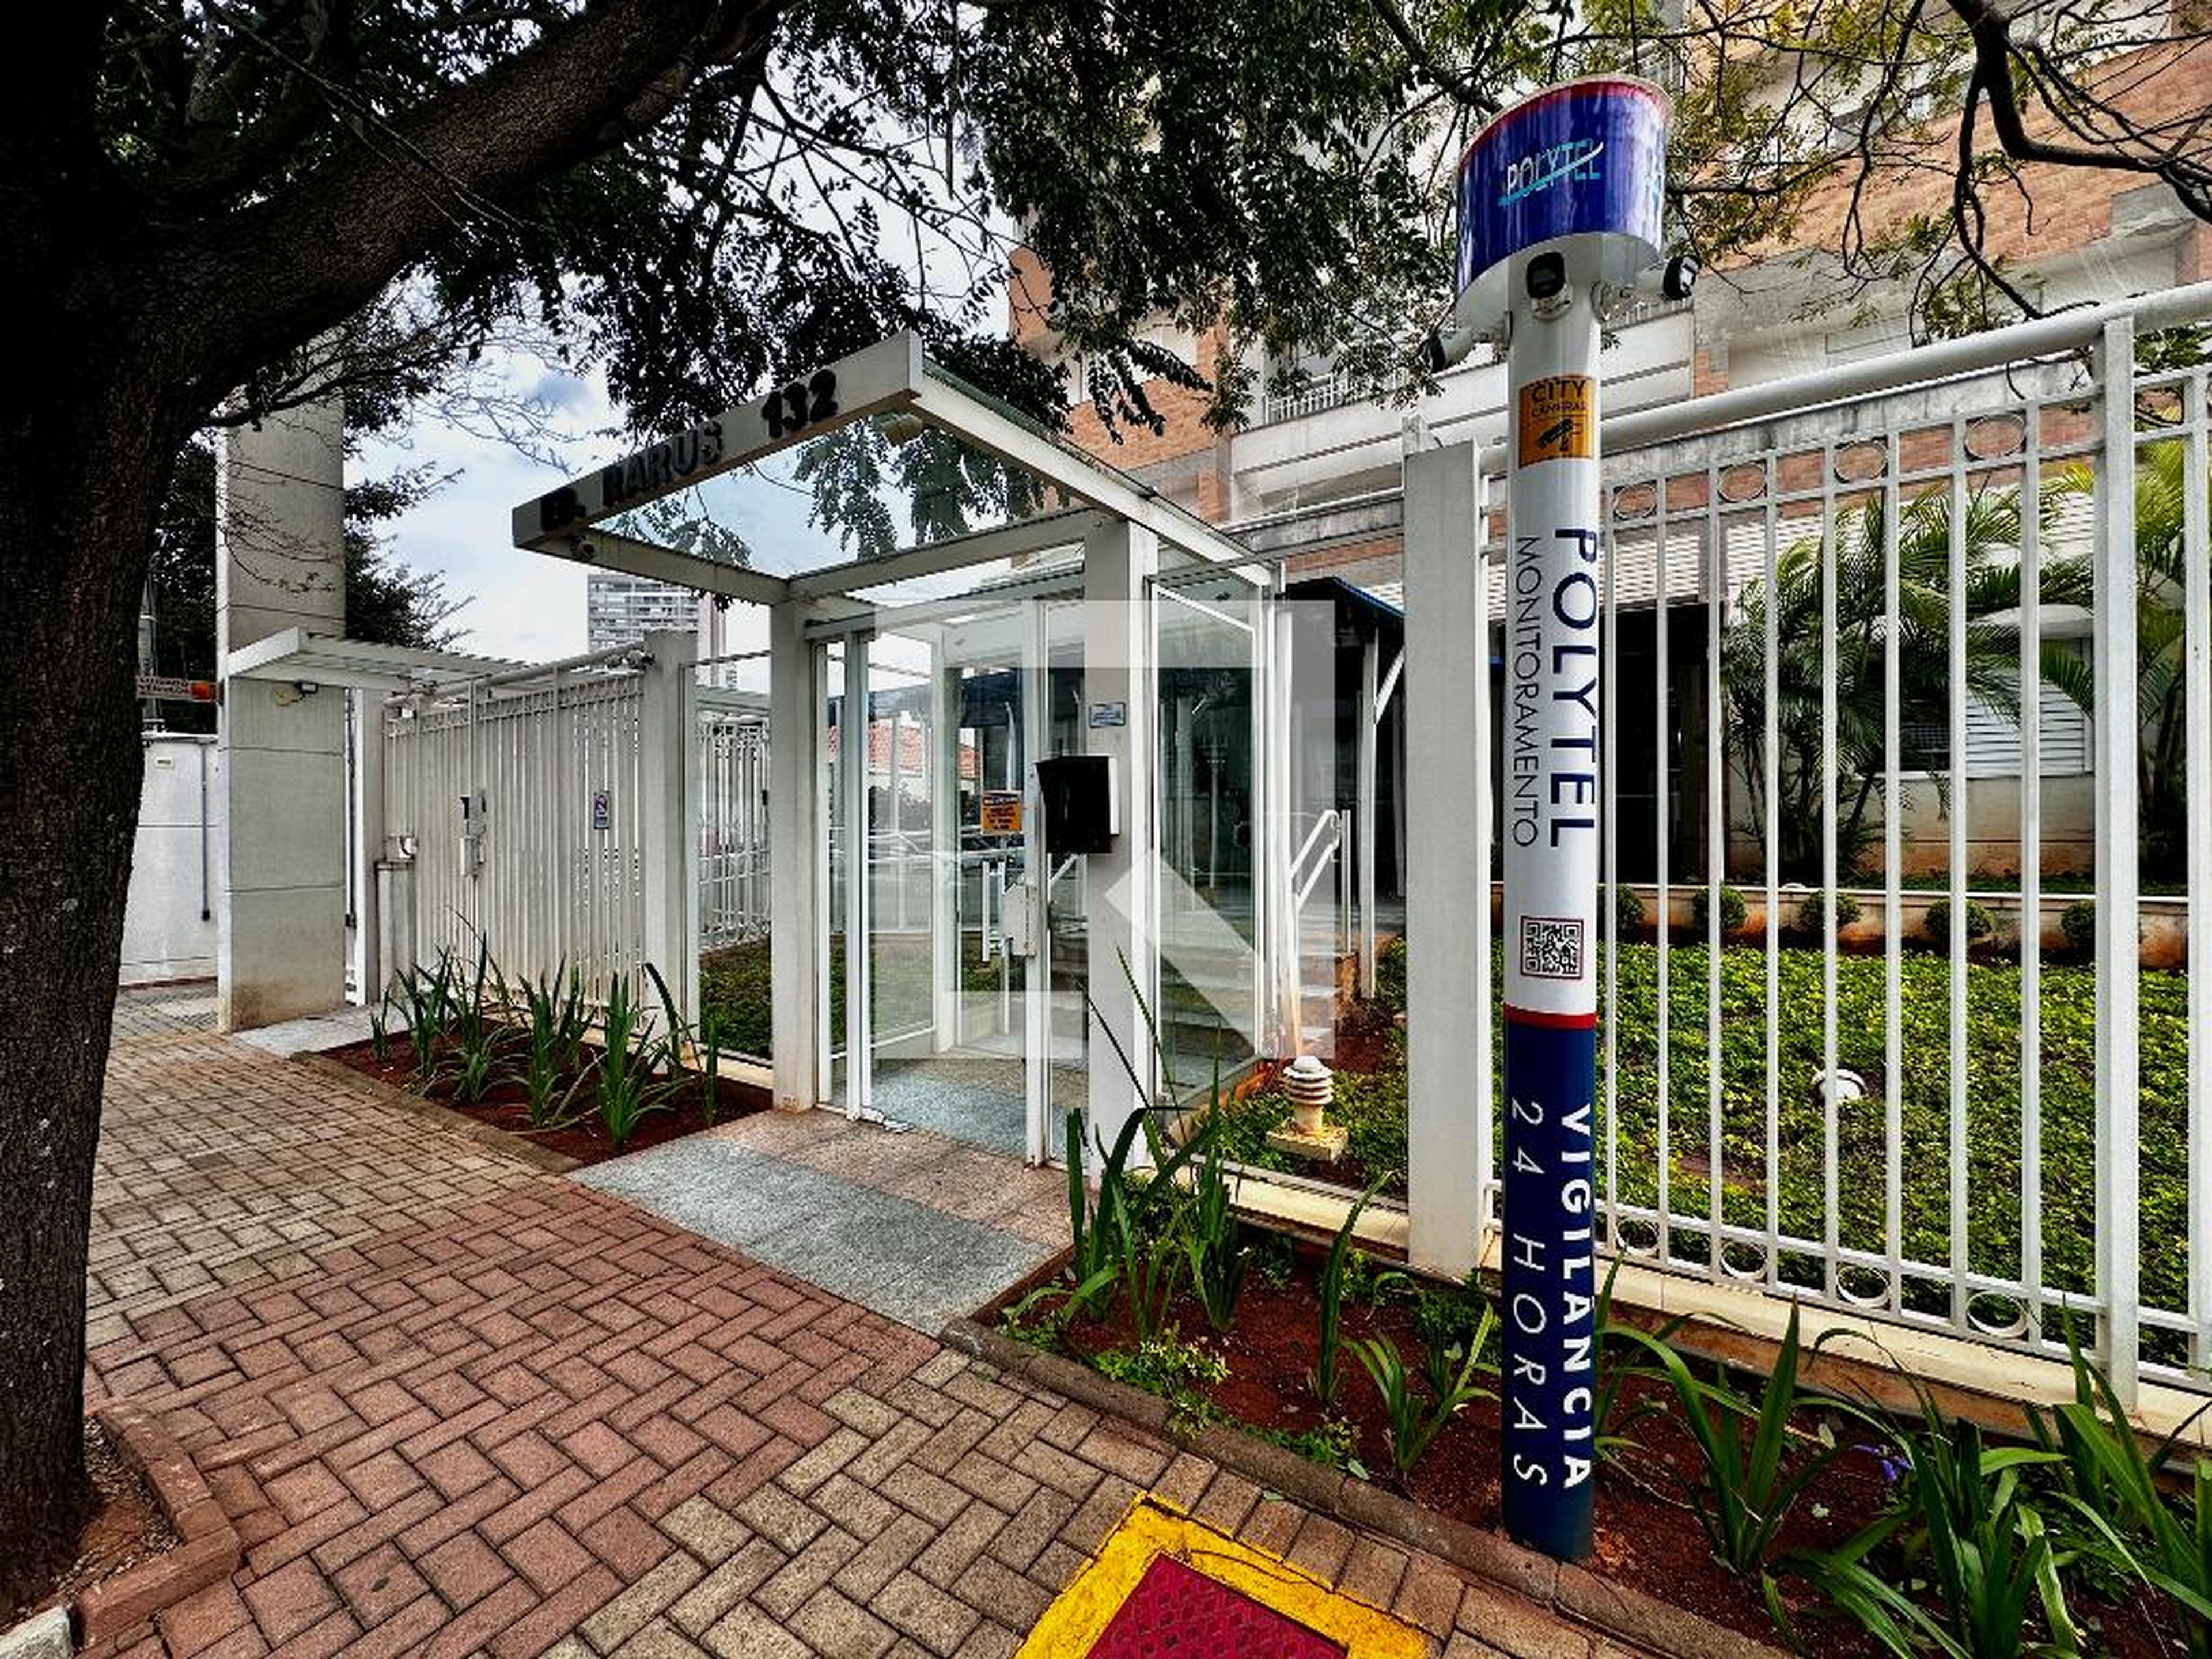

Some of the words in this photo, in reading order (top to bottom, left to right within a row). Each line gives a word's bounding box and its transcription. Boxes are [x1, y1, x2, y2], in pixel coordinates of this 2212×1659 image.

[1507, 138, 1601, 197] POLYTEL
[761, 369, 838, 438] 132
[1532, 380, 1586, 402] CITY
[1513, 536, 1541, 848] MONITORAMENTO
[1551, 528, 1597, 847] POLYTEL
[1512, 1097, 1545, 1175] 24
[1513, 1233, 1547, 1487] HORAS
